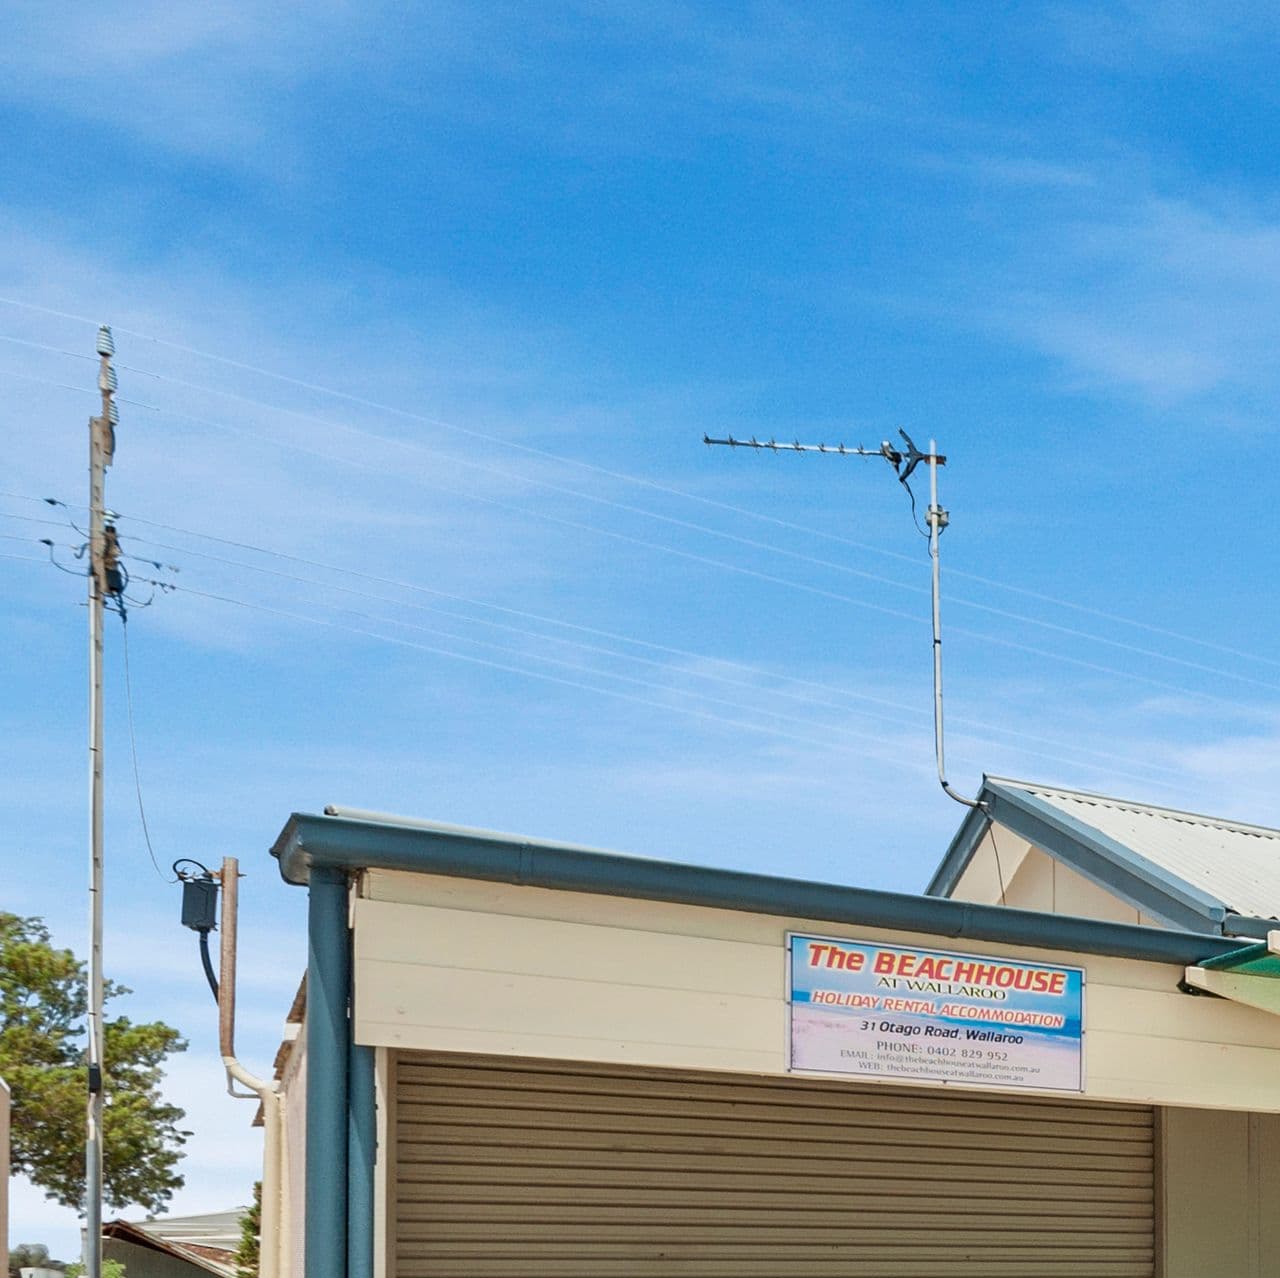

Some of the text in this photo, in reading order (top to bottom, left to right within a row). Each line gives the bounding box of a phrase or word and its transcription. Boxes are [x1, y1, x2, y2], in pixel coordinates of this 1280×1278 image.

[810, 944, 1066, 994] The BEACHHOUSE
[877, 977, 1006, 1000] AT WALLAROO
[812, 991, 1063, 1027] HOLIDAY RENTAL ACCOMMODATION
[860, 1020, 876, 1031] 31
[879, 1021, 921, 1036] Otago
[966, 1029, 1024, 1045] Wallaroo
[876, 1041, 1008, 1062] PHONE: 0402 829 952
